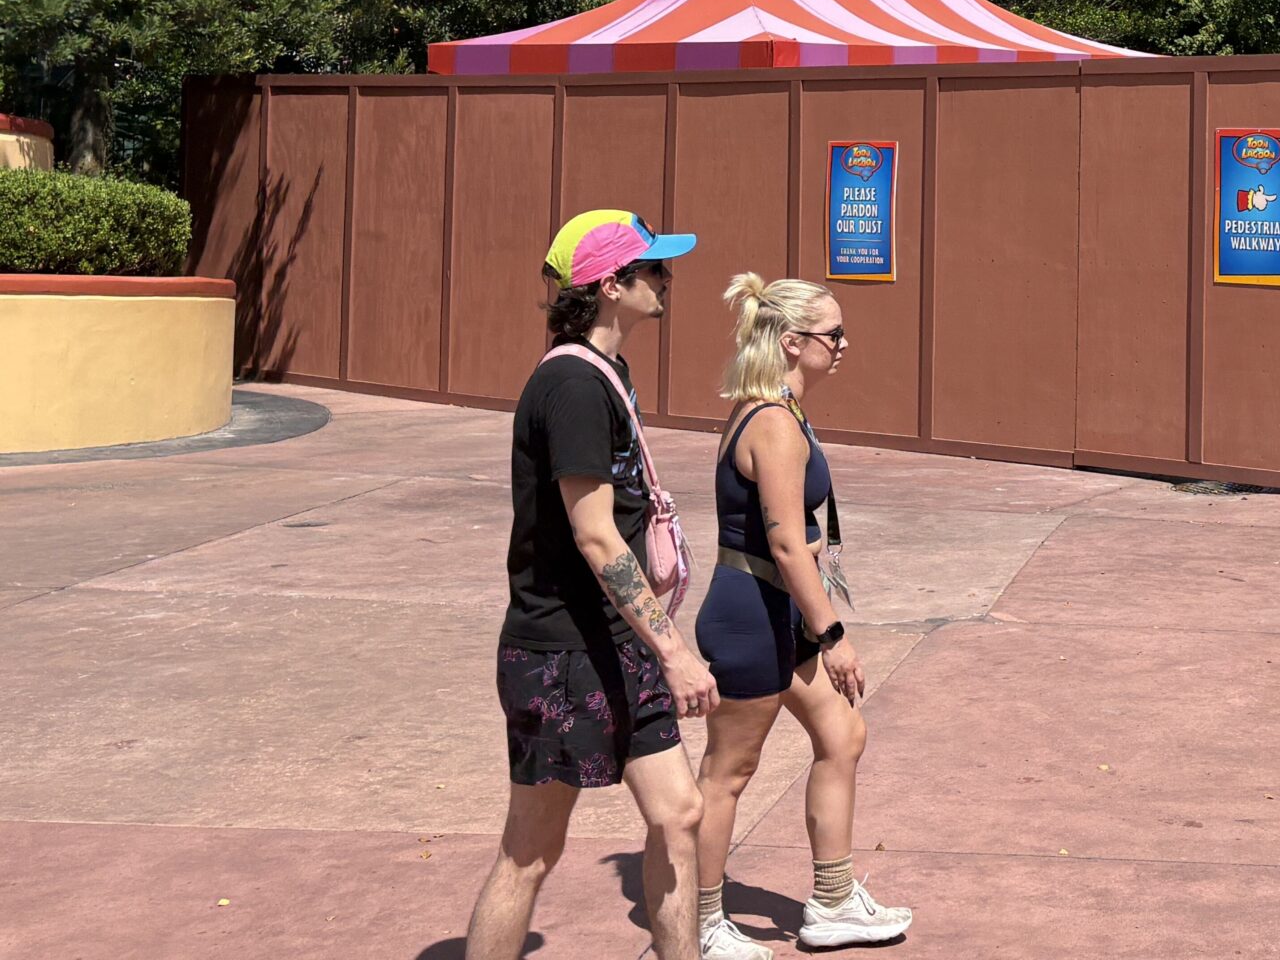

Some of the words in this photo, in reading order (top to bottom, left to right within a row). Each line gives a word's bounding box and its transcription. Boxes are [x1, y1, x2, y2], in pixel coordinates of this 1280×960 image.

[843, 187, 876, 201] PLEASE
[841, 203, 878, 217] PARDON
[836, 220, 855, 233] OUR
[859, 220, 883, 234] DUST
[840, 247, 857, 255] THANK
[858, 248, 868, 256] YOU
[869, 248, 879, 256] FOR
[850, 256, 884, 265] COOPERATION
